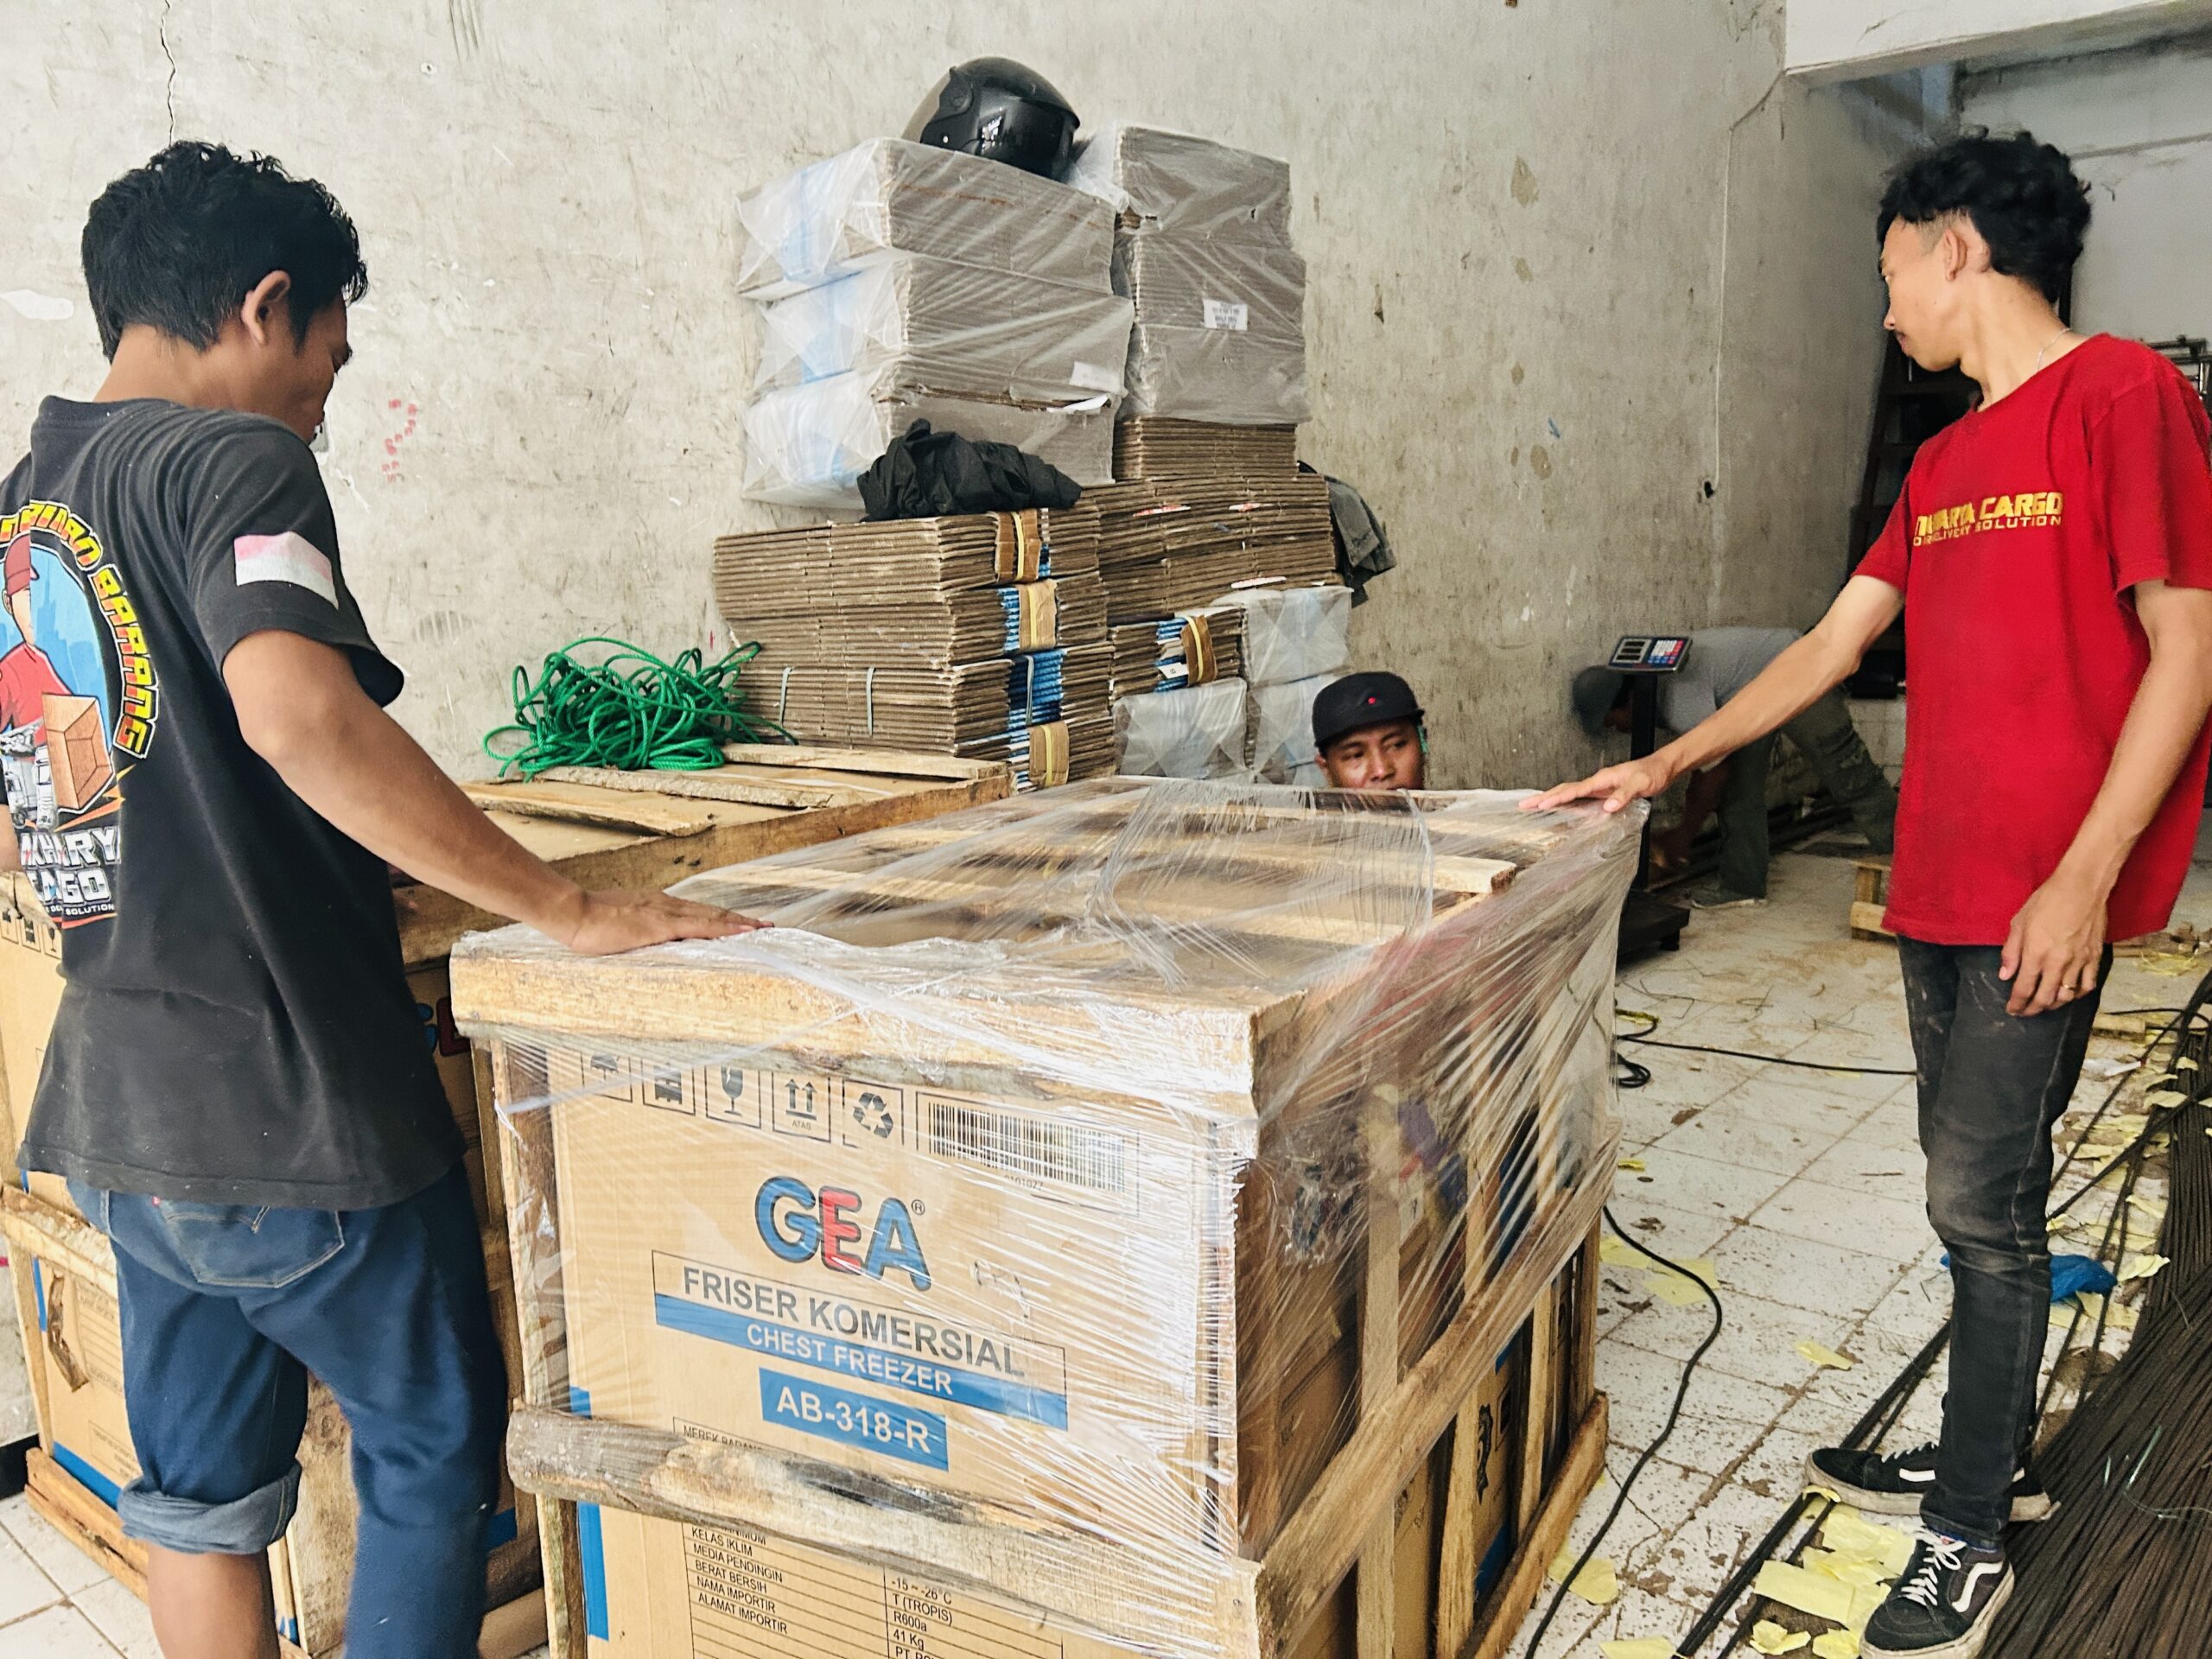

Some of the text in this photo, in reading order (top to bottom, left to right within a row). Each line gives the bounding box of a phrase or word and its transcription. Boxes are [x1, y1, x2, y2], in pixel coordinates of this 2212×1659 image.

[1979, 492, 2063, 520] CARGO
[92, 567, 155, 754] BARANG
[65, 904, 115, 916] SOLUTION
[683, 1266, 1026, 1377] FRISER KOMERSIAL
[747, 1322, 954, 1396] CHEST FREEZER
[776, 1386, 931, 1454] AB-318-R
[691, 1526, 753, 1556] KELAS IKLIM
[694, 1542, 783, 1583] MEDIA PENDINGIN
[695, 1559, 767, 1594] BERAT BERSIH
[696, 1575, 776, 1614] NAMA IMPORTIR
[893, 1592, 952, 1627] T (TROPIS)
[698, 1592, 788, 1635] ALAMAT IMPORTIR
[893, 1611, 927, 1632] R600a
[893, 1628, 925, 1651] 41 Kg
